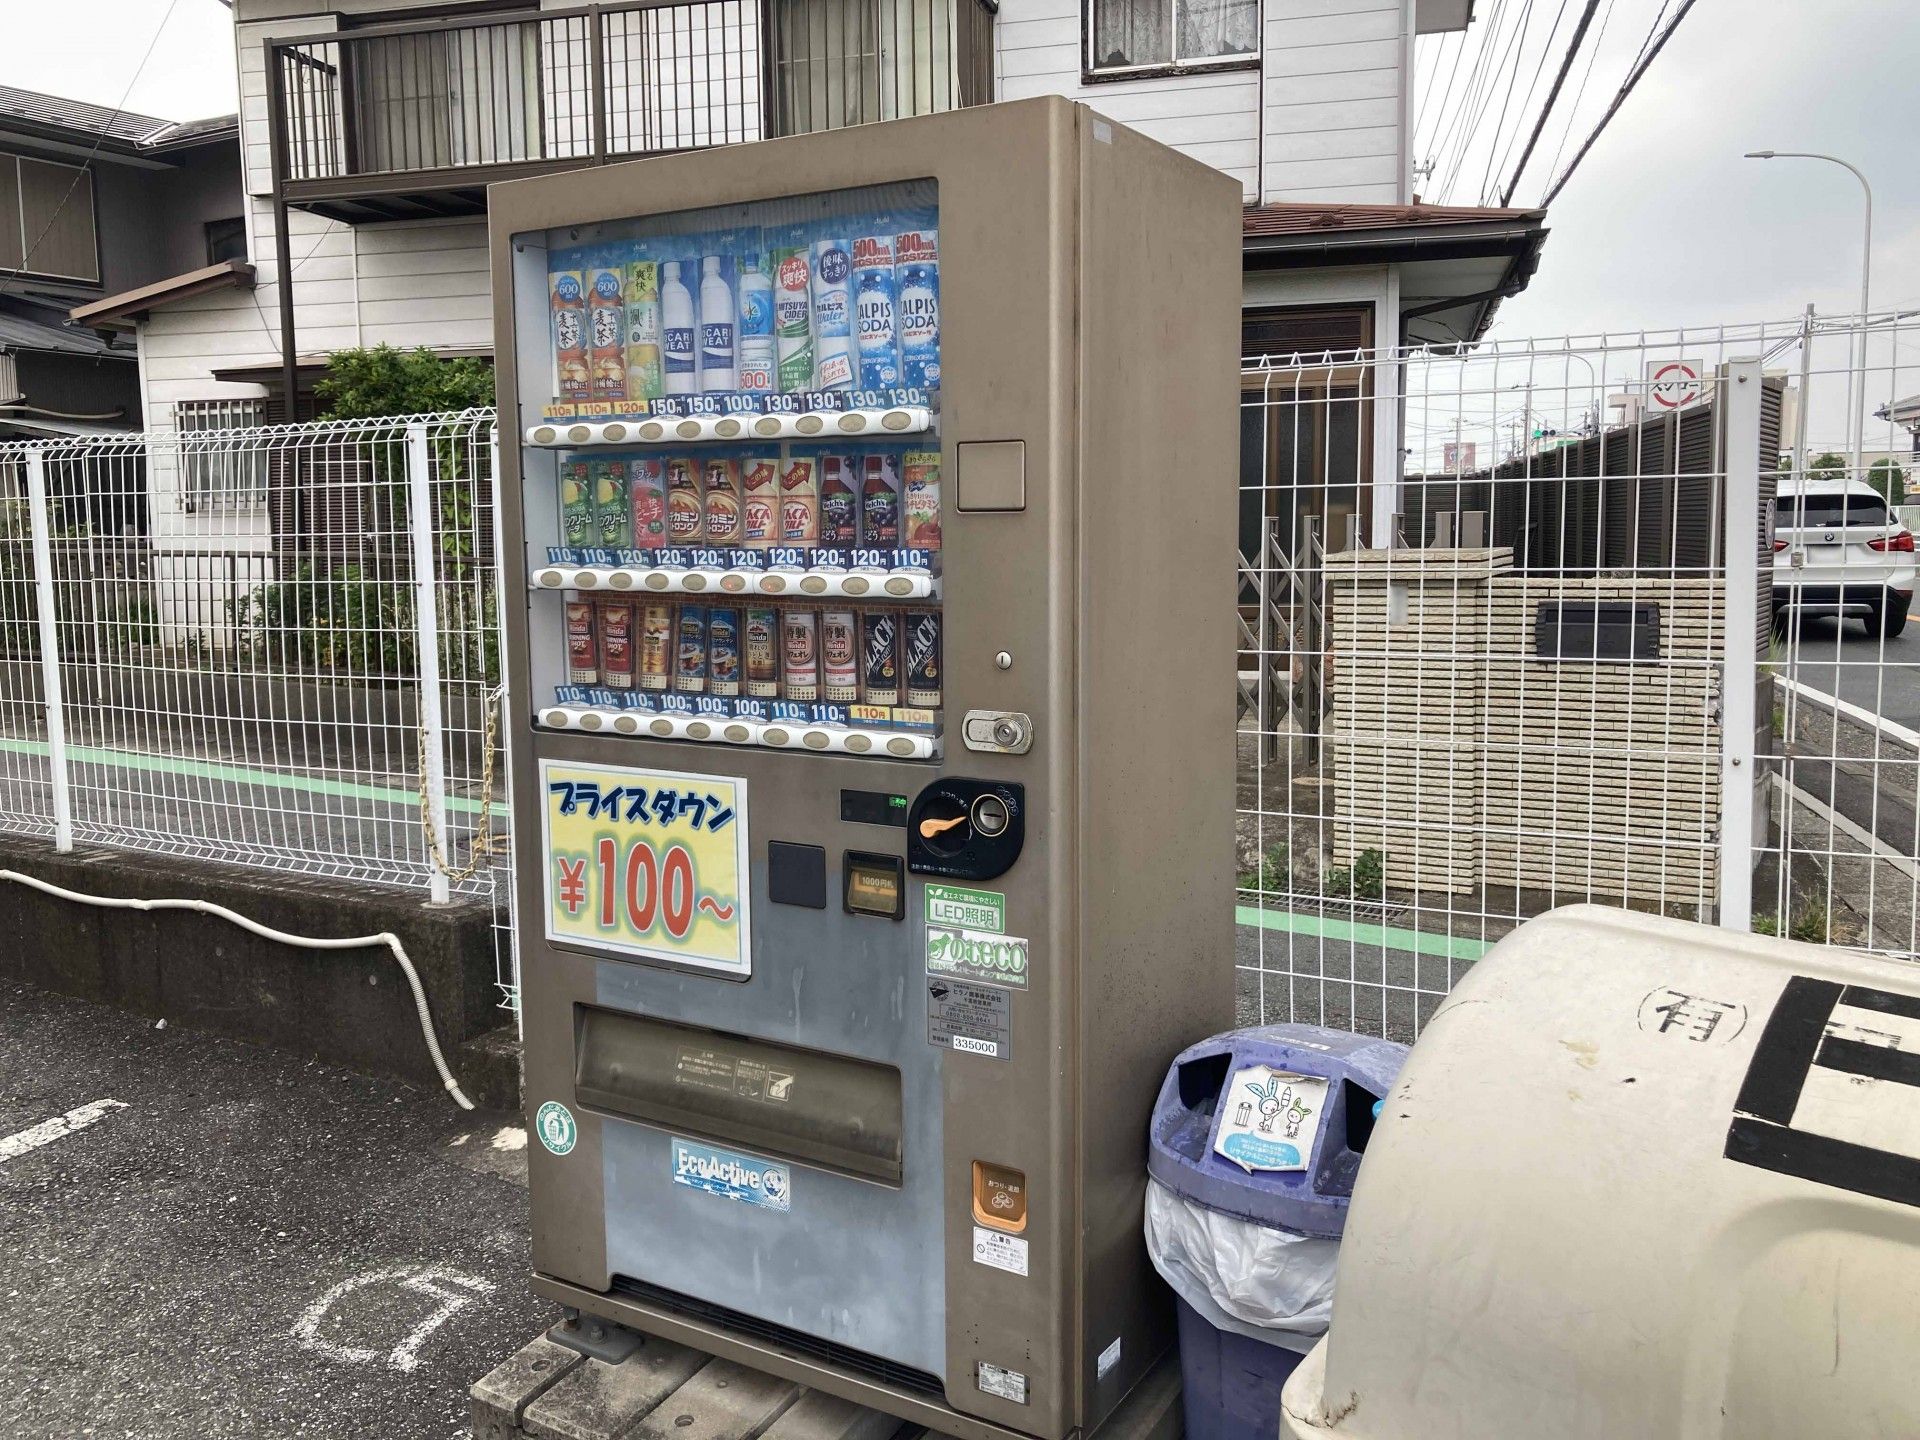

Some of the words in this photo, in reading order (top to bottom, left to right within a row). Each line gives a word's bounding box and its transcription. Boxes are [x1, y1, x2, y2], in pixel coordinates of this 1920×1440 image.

[597, 281, 617, 292] 600
[635, 268, 646, 293] 爽快
[559, 284, 578, 294] 600
[784, 310, 808, 319] CIDER
[858, 302, 891, 319] ALPIS
[559, 312, 573, 349] 麦茶
[595, 310, 609, 346] 麦茶
[723, 395, 760, 411] 100円
[764, 395, 799, 411] 130円
[806, 392, 842, 410] 130円
[846, 390, 885, 408] 130円
[889, 387, 928, 405] 130円
[548, 406, 571, 416] 110円
[584, 404, 608, 415] 110円
[619, 403, 645, 414] 120円
[650, 399, 682, 414] 150円
[687, 396, 720, 413] 150円
[549, 550, 577, 563] 110円
[581, 550, 612, 564] 110円
[617, 550, 649, 564] 120円
[655, 550, 687, 565] 120円
[691, 550, 724, 566] 120円
[730, 550, 763, 566] 120円
[769, 549, 803, 564] 120円
[811, 549, 845, 566] 120円
[851, 550, 887, 566] 120円
[892, 550, 928, 566] 110円
[557, 687, 586, 701] 110円
[590, 690, 618, 705] 110円
[624, 692, 654, 708] 110円
[661, 694, 692, 711] 100円
[696, 697, 728, 713] 100円
[734, 699, 766, 716] 100円
[772, 702, 806, 719] 110円
[812, 705, 845, 722] 110円
[857, 707, 885, 719] 110円
[899, 709, 928, 722] 110円
[550, 782, 733, 831] プライスダウン
[935, 903, 994, 927] LED照明
[955, 1037, 995, 1054] 335000
[677, 1147, 760, 1189] EcoActive
